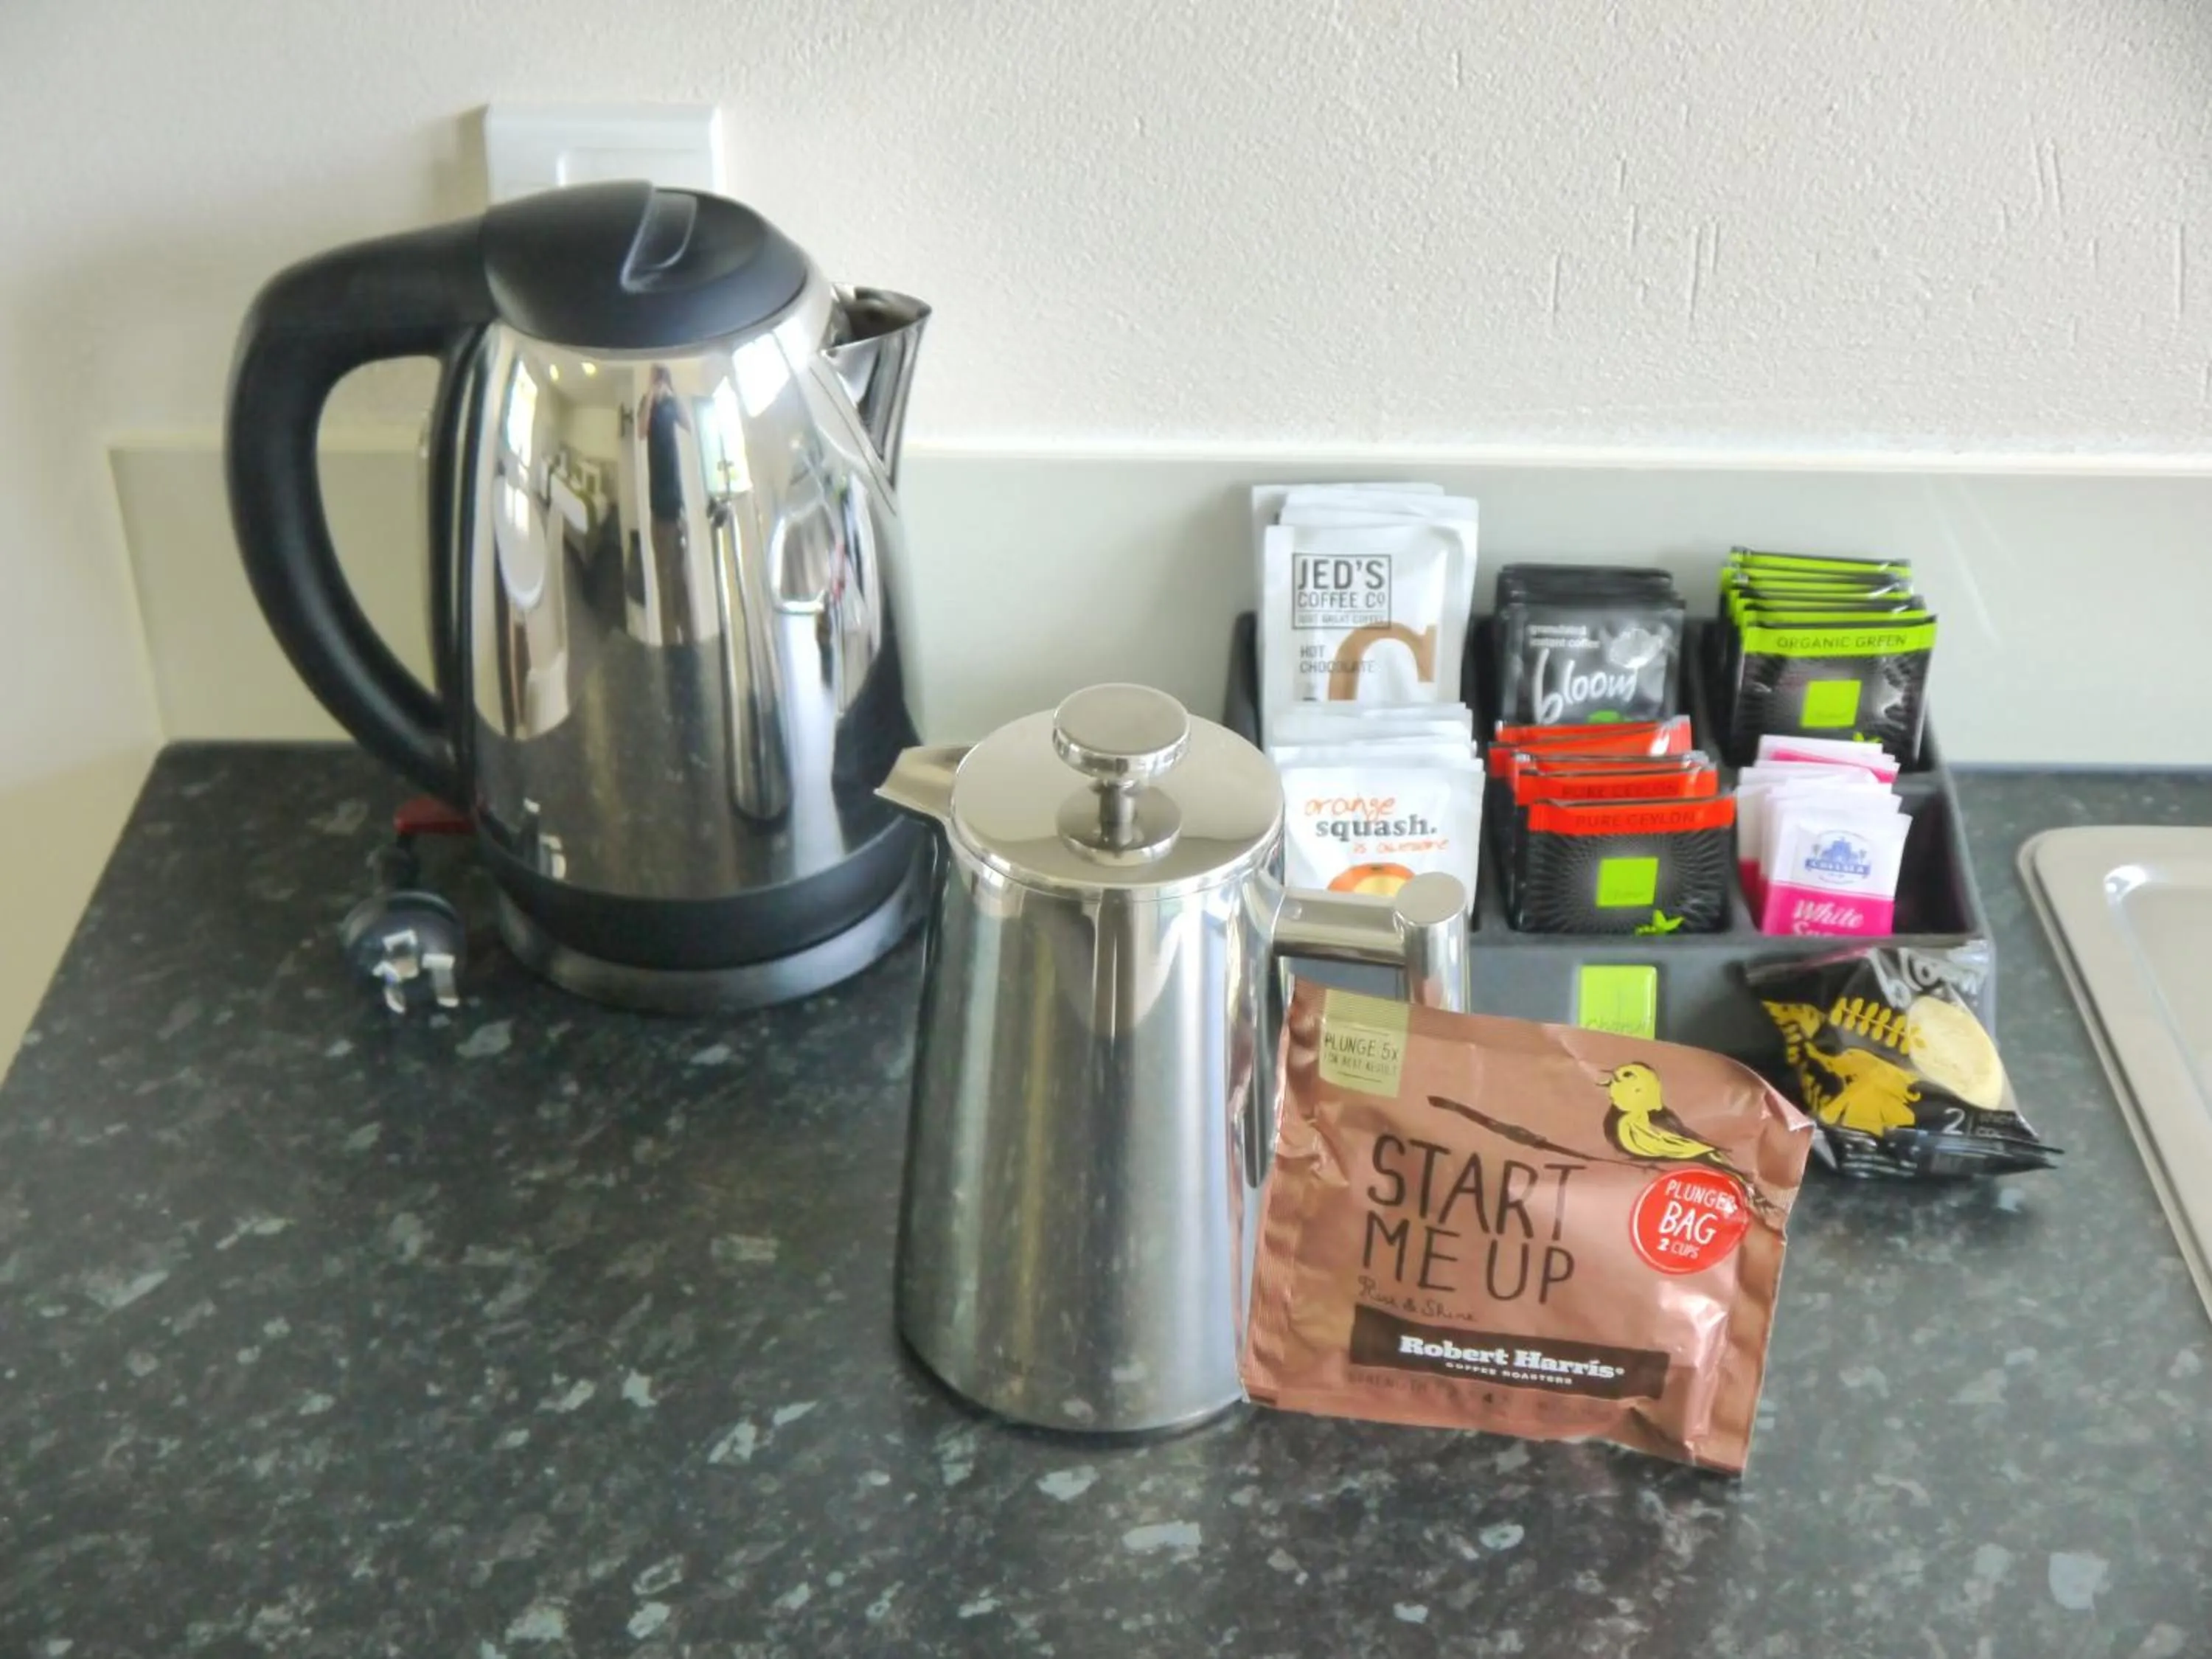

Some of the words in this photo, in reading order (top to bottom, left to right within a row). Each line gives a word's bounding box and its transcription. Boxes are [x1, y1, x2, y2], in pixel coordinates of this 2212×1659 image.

[1298, 558, 1385, 591] JED'S
[1298, 591, 1358, 609] COFFEE
[1299, 645, 1326, 658] HOT
[1777, 636, 1851, 650] ORGANIC
[1855, 634, 1907, 647] GREEN
[1299, 660, 1375, 674] CHOCOLATE
[1533, 648, 1638, 724] bloom
[1304, 795, 1396, 821] orange
[1576, 815, 1618, 829] PURE
[1626, 810, 1695, 827] CEYLON
[1315, 813, 1439, 842] squash.
[1793, 900, 1865, 929] White
[1325, 1032, 1377, 1057] PLUNGE
[1942, 1107, 1965, 1135] 2
[1368, 1133, 1587, 1241] START
[1658, 1200, 1718, 1245] BAG
[1363, 1210, 1460, 1292] ME
[1486, 1239, 1575, 1305] UP
[1658, 1238, 1670, 1251] 2
[1671, 1241, 1701, 1259] CUPS
[1421, 1298, 1478, 1323] Shine
[1399, 1335, 1509, 1366] Robert
[1445, 1362, 1497, 1376] COFFEE
[1501, 1369, 1573, 1385] ROASTERS
